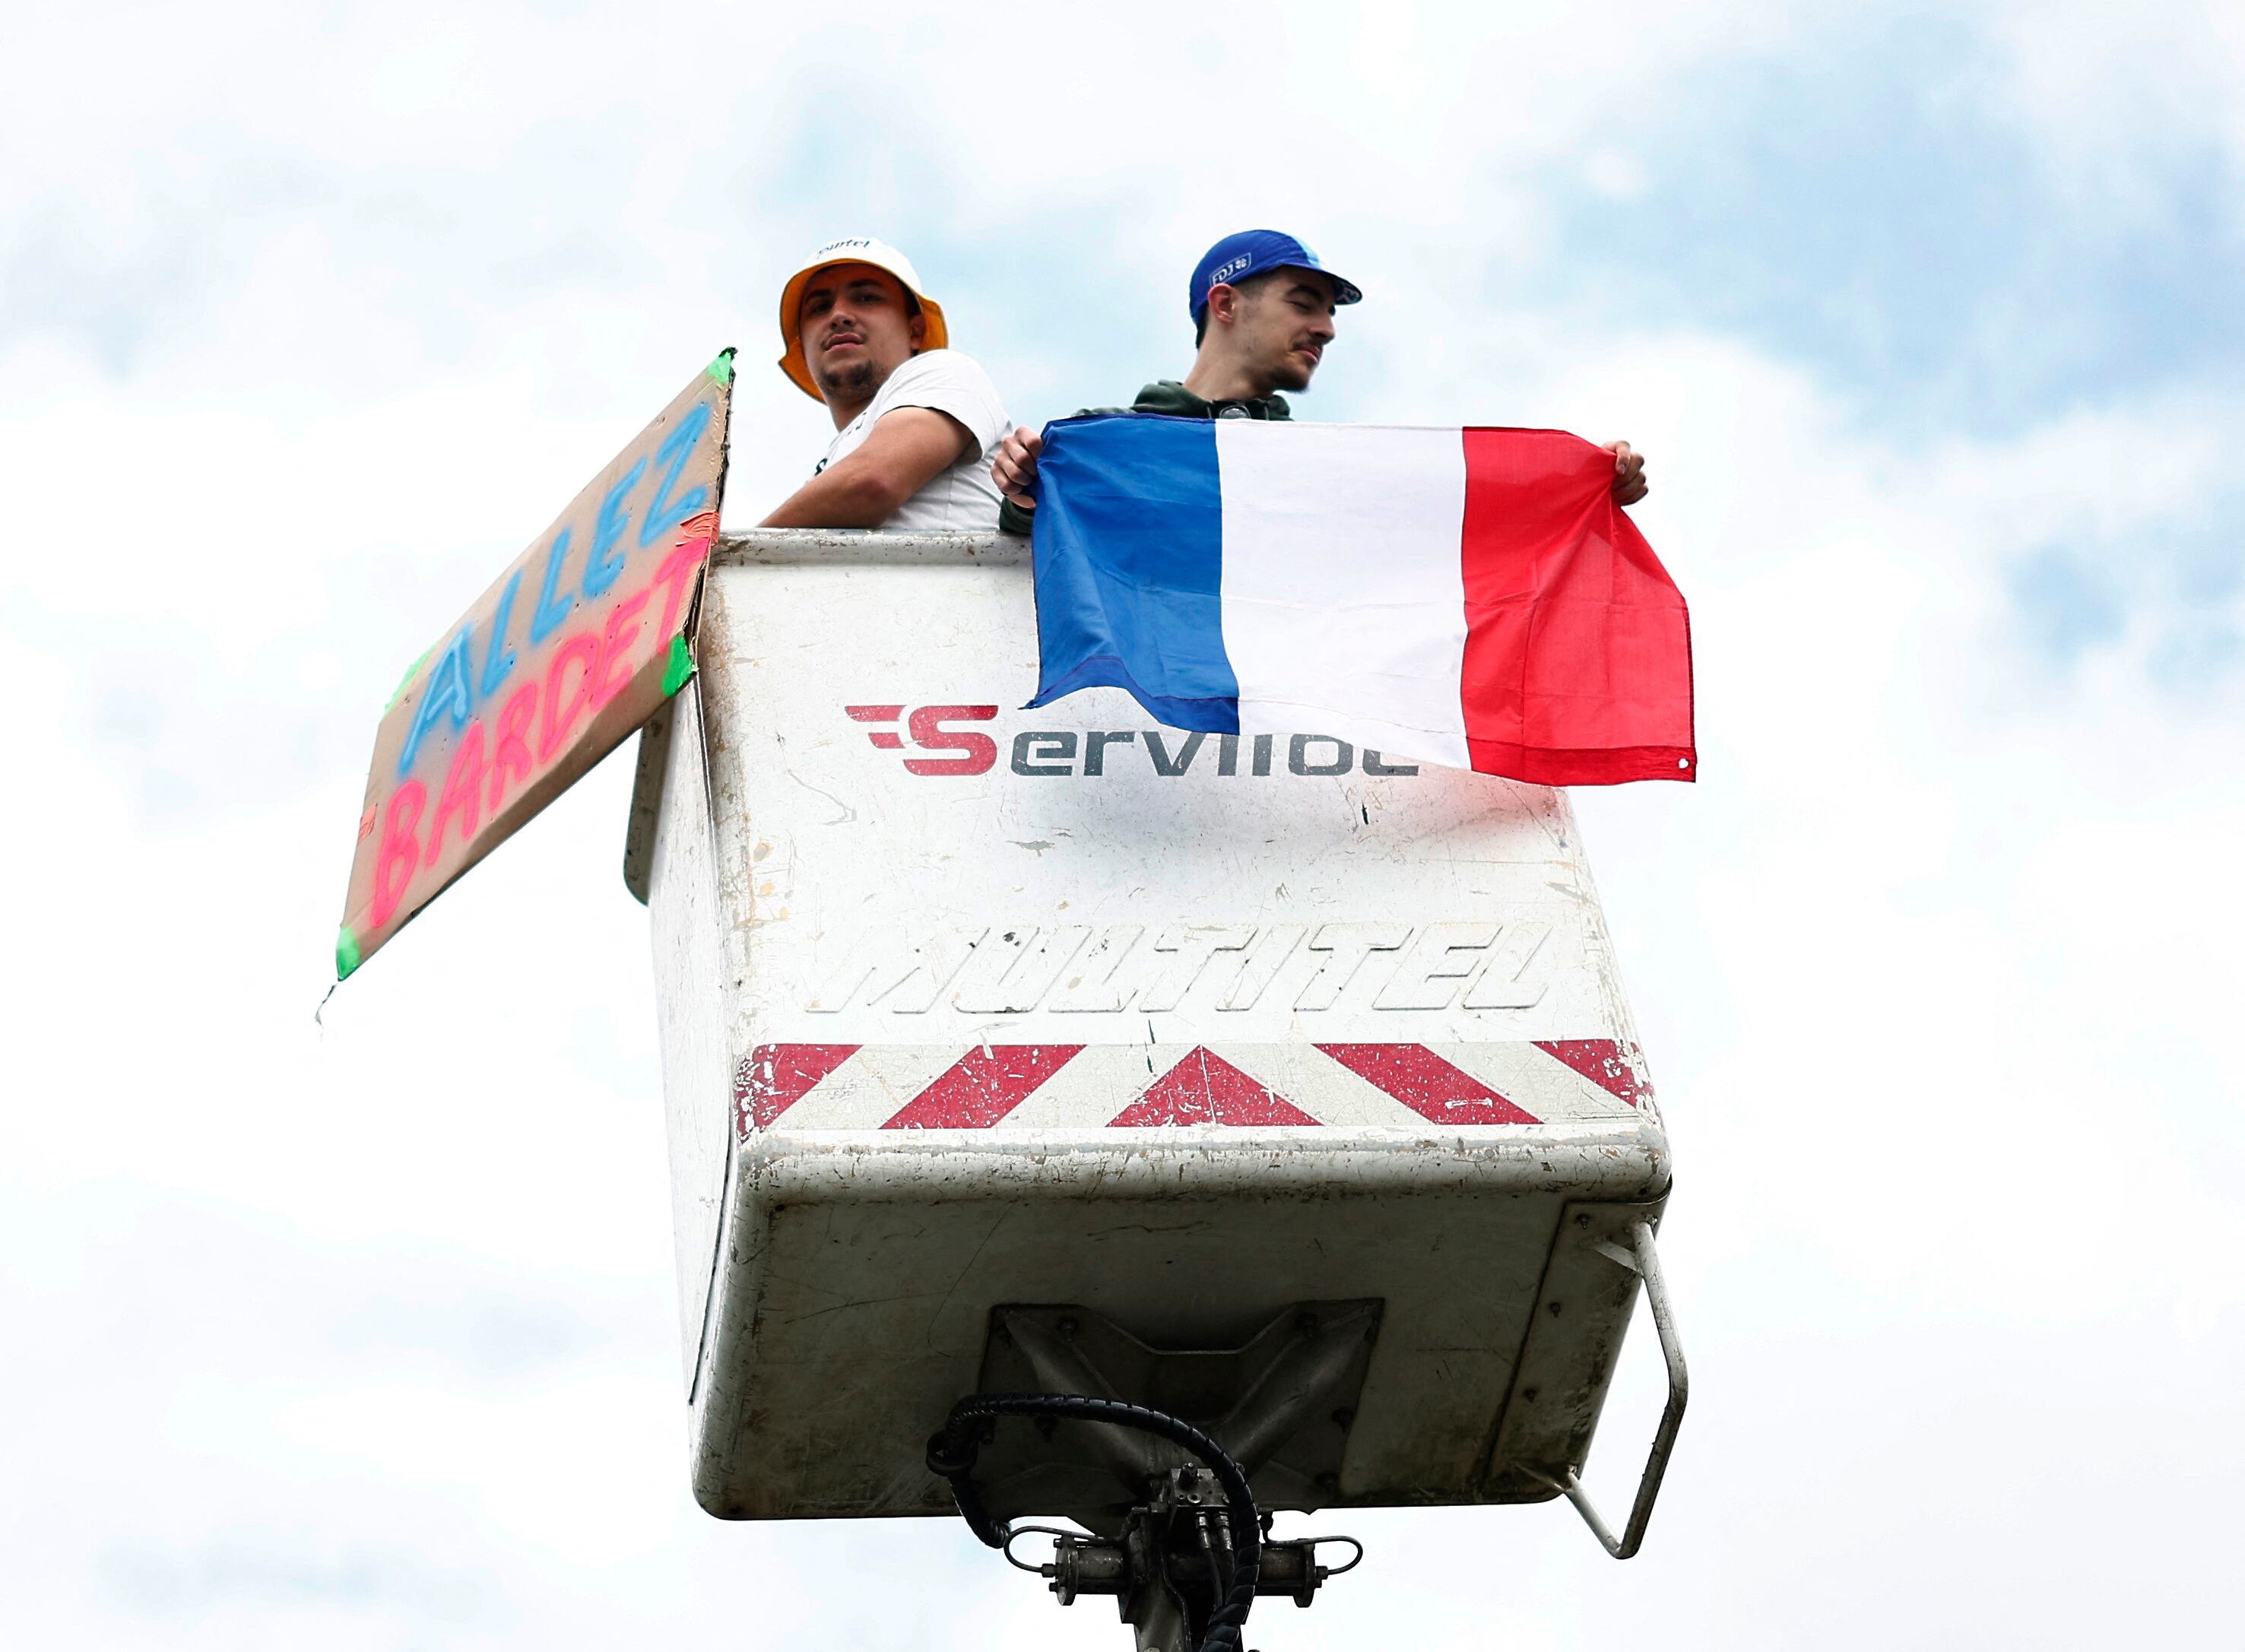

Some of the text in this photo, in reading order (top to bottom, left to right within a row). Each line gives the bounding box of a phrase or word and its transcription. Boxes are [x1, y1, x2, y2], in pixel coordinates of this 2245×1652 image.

[369, 537, 712, 927] BARDET
[396, 401, 712, 775] ALLEZ
[804, 923, 1557, 1014] MULTITEL
